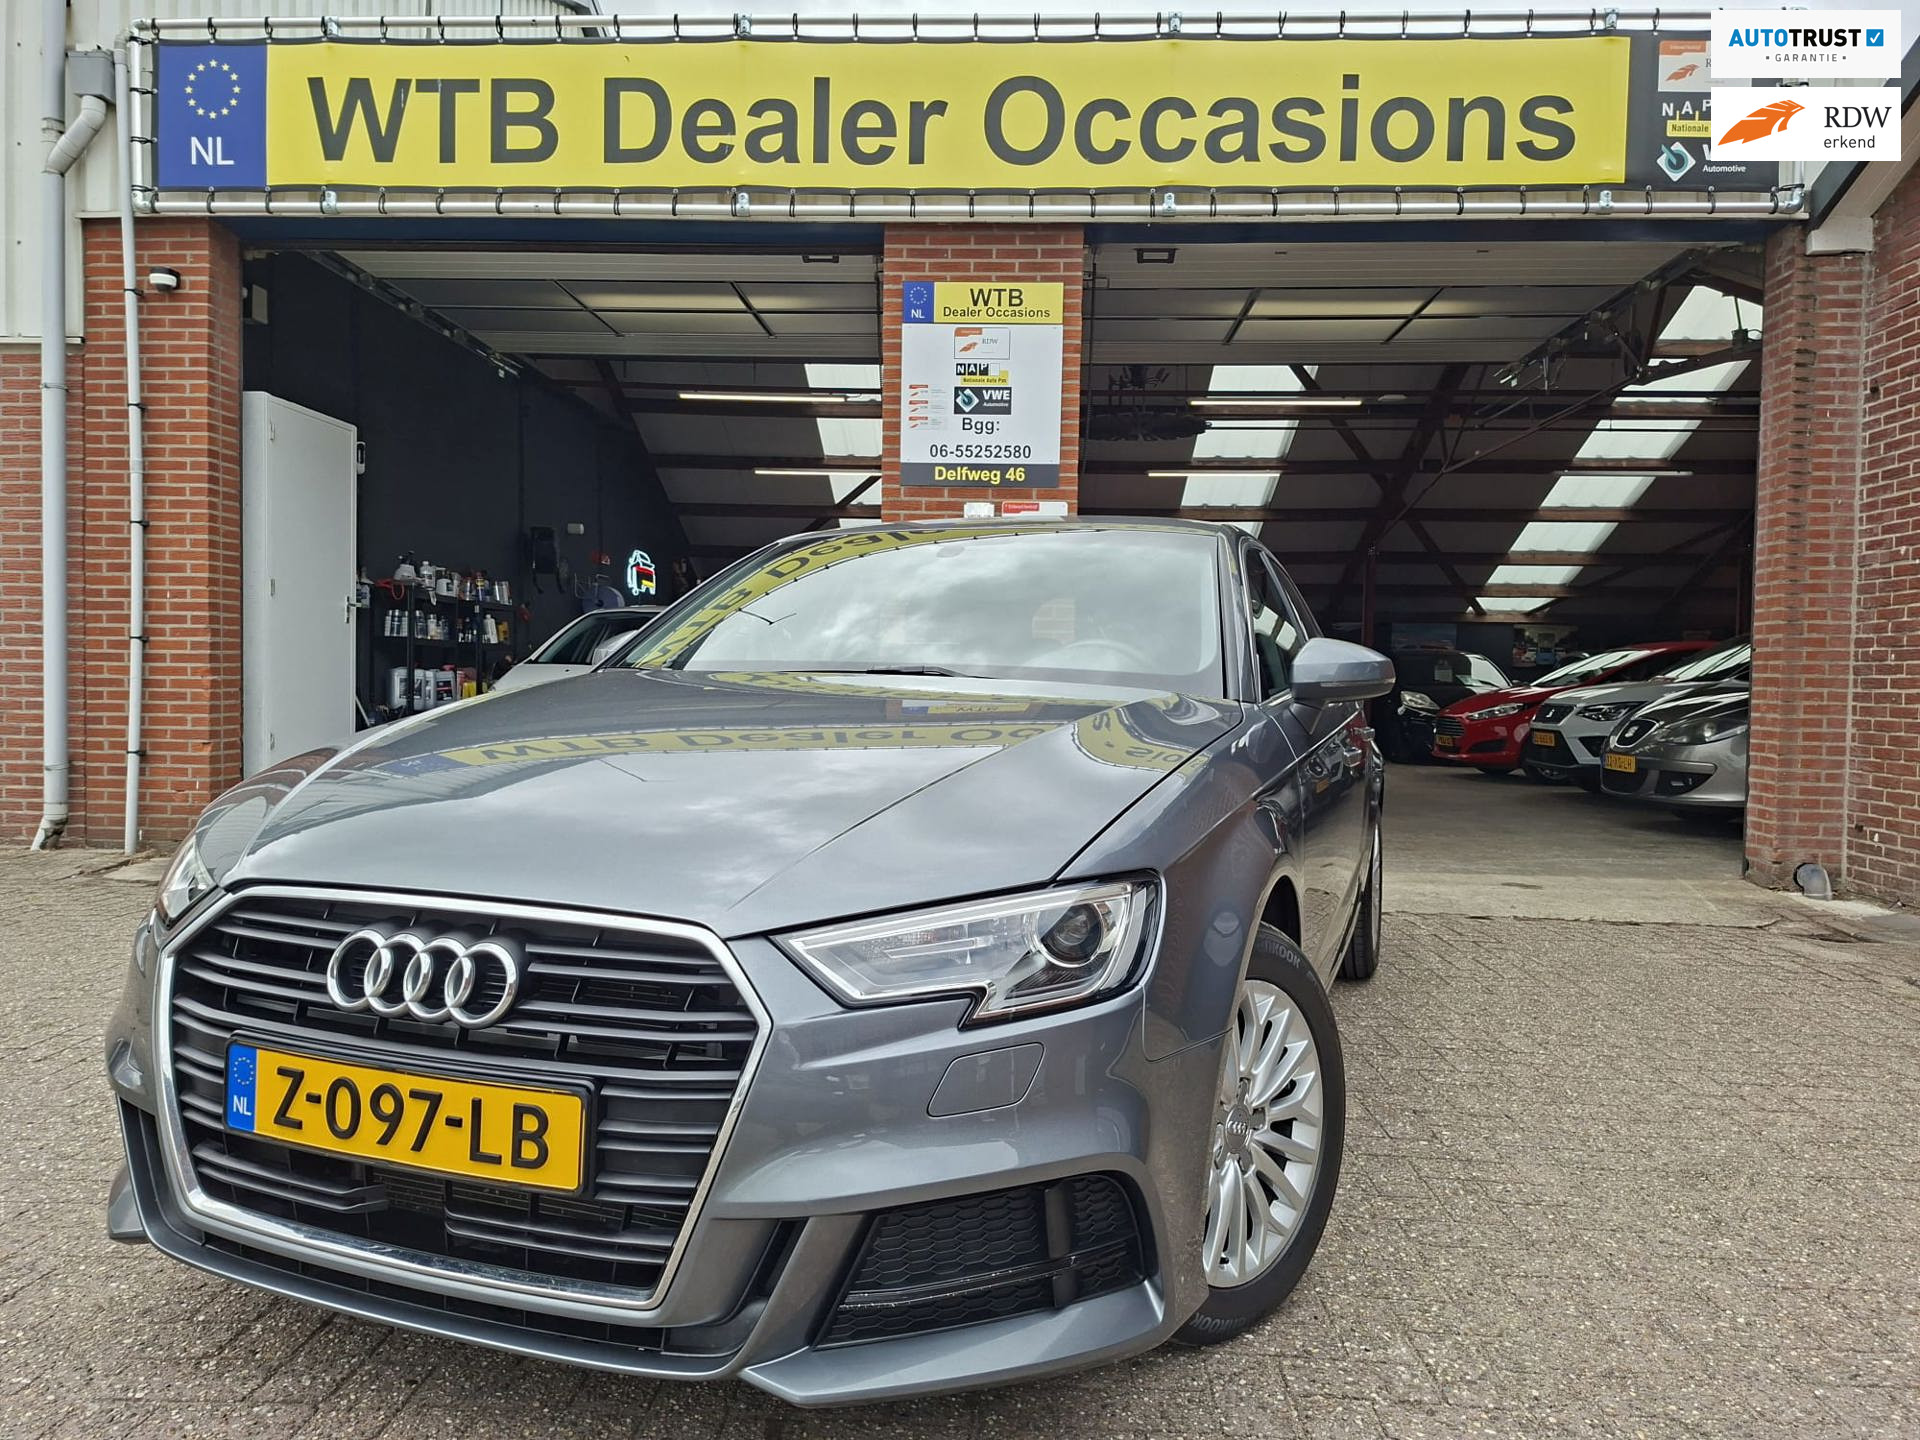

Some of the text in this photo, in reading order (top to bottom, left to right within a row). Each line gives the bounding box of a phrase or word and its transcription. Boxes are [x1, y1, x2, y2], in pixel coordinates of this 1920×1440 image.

[307, 74, 1576, 165] WTB Dealer Occasions
[191, 137, 234, 165] NL
[1703, 164, 1746, 173] Automotive
[970, 288, 1023, 306] WTB
[911, 309, 925, 319] NL
[943, 306, 1050, 318] Dealer Occasions
[957, 364, 988, 374] NAP
[982, 390, 1010, 400] VWE
[962, 418, 1000, 435] Bgg:
[930, 444, 1031, 459] 06-55252580
[934, 466, 1025, 484] Delfweg 46
[233, 1095, 252, 1116] NL
[273, 1066, 549, 1169] Z-097-LB
